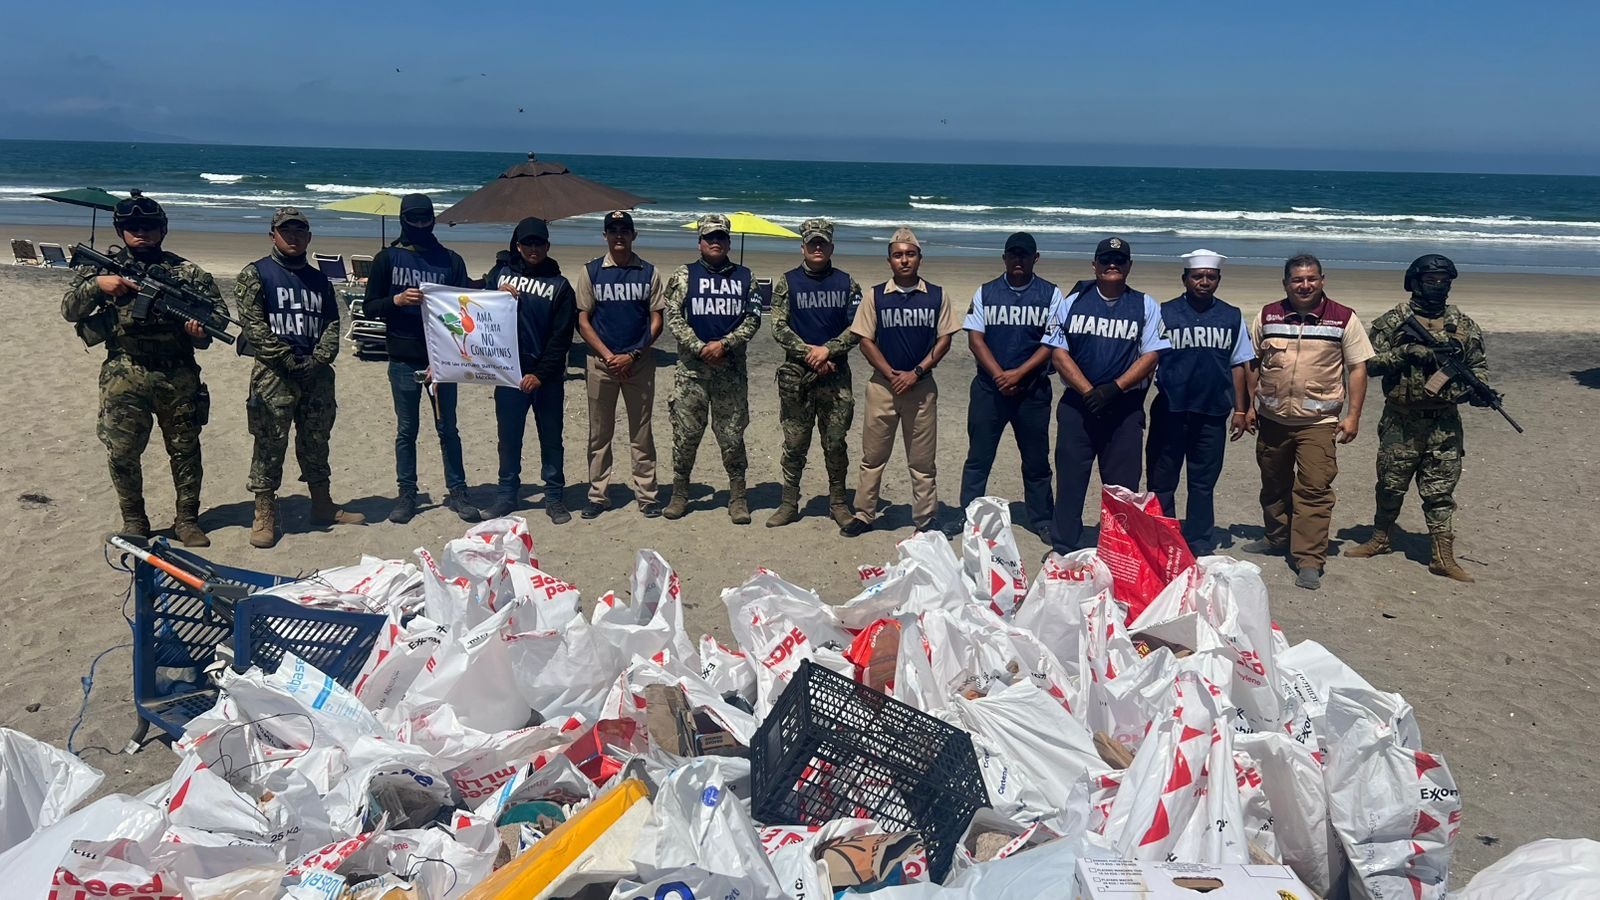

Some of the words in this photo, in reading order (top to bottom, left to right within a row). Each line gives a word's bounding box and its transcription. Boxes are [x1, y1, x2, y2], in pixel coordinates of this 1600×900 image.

[593, 283, 651, 301] MARINA
[699, 278, 742, 296] PLAN
[276, 287, 323, 313] PLAN
[796, 290, 846, 309] MARINA
[476, 311, 493, 322] AMA
[881, 308, 935, 328] MARINA
[984, 305, 1049, 326] MARINA
[1068, 314, 1139, 340] MARINA
[481, 333, 494, 347] NO
[1166, 326, 1232, 350] MARINA
[470, 344, 512, 358] CONTAMINES
[1420, 787, 1459, 801] Exxon
[270, 831, 284, 843] 25
